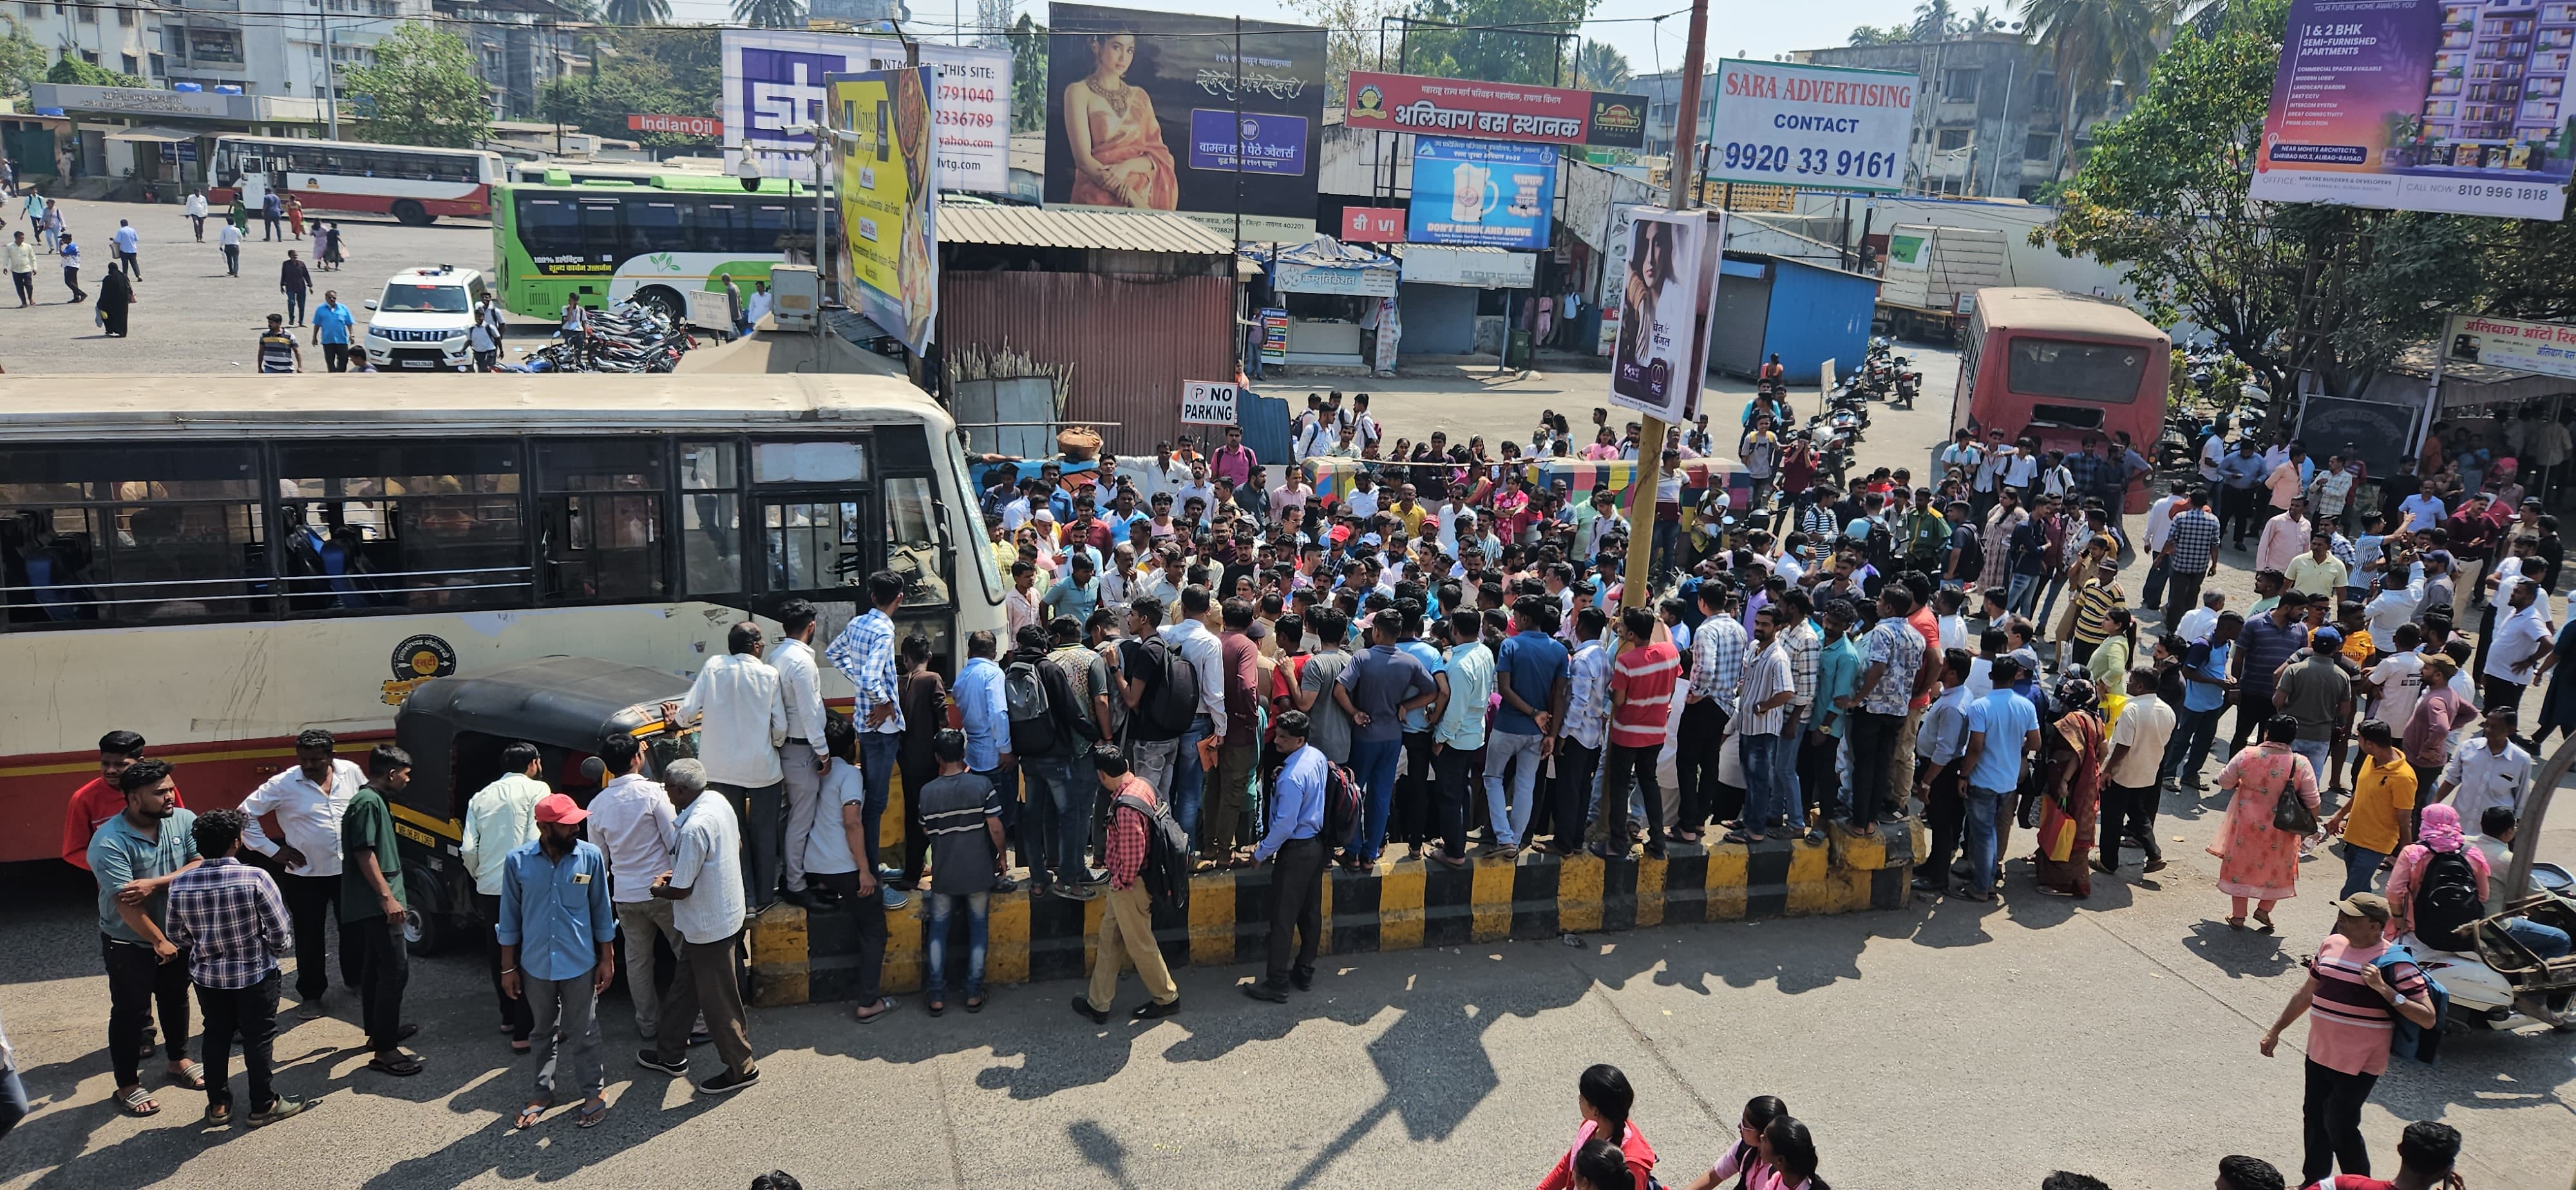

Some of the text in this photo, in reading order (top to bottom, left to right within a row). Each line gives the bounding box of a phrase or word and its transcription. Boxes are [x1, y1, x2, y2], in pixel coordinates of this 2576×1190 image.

[2306, 24, 2363, 36] 1 & 2 BHK
[2303, 37, 2376, 46] SEMI-FURNISHED
[2301, 46, 2359, 56] APARTMENTS
[943, 64, 965, 77] THIS
[971, 66, 994, 79] SITE:
[1443, 87, 1457, 96] राज्य
[1458, 87, 1470, 97] मार्ग
[1471, 89, 1493, 99] परिवहन
[1524, 94, 1541, 103] रायगड
[1542, 93, 1560, 104] विभाग
[1725, 72, 1911, 108] SARA ADVERTISING
[936, 110, 994, 128] 2336789
[1395, 100, 1475, 131] अलिबाग
[1478, 111, 1509, 133] बस
[1512, 114, 1581, 138] स्थानक
[1774, 114, 1859, 133] CONTACT
[1199, 142, 1227, 153] वामन
[1247, 142, 1262, 156] पेठे
[1725, 142, 1895, 178] 9920 33 9161
[2458, 185, 2482, 196] 810
[2486, 186, 2513, 198] 996
[2517, 188, 2548, 201] 1818
[1353, 214, 1368, 231] वी
[1427, 222, 1532, 236] DON'T DRINK AND DRIVE
[1302, 271, 1356, 288] कम्युनिकेशन
[2463, 318, 2520, 336] अलिबाग
[2522, 325, 2553, 341] ऑटो
[2536, 344, 2563, 358] अलिबाग
[1211, 388, 1233, 402] NO
[1651, 383, 1662, 393] PNG
[1184, 404, 1233, 420] PARKING
